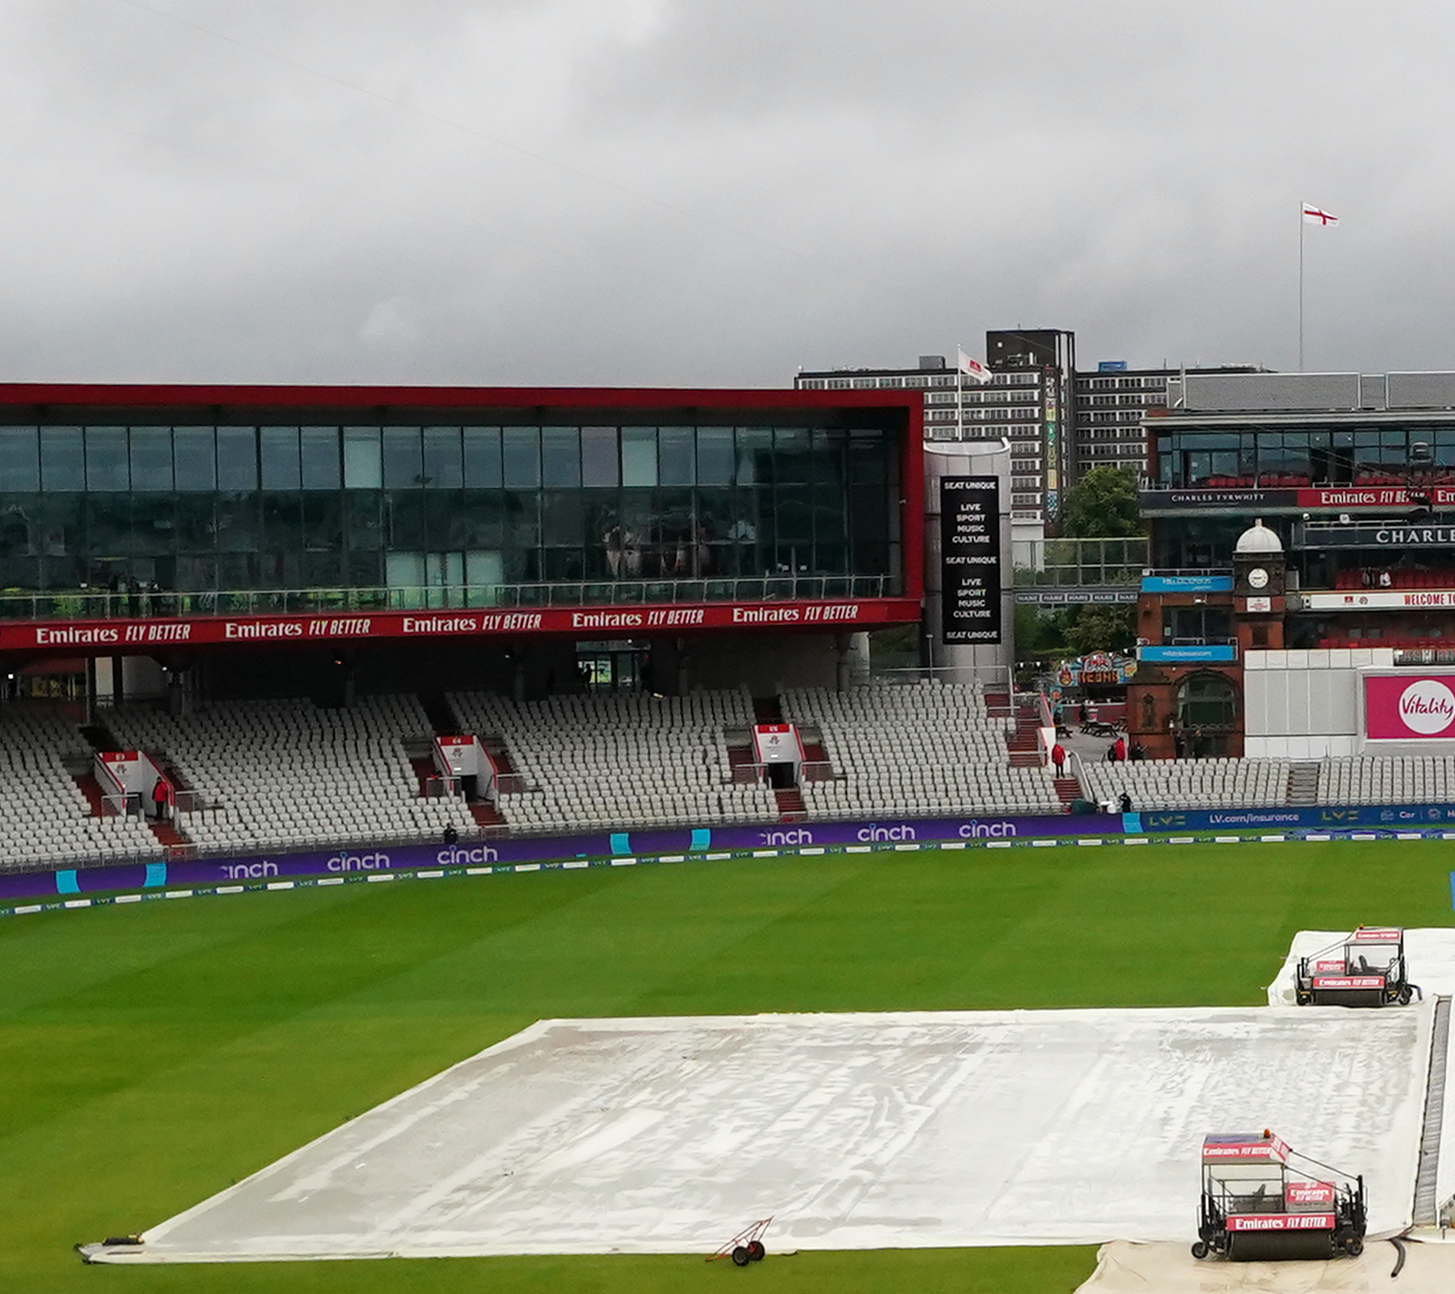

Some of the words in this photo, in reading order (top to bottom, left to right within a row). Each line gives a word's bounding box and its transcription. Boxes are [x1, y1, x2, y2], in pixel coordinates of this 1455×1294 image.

[1321, 491, 1376, 504] Emirates
[1380, 491, 1394, 502] FLY
[1404, 595, 1444, 605] WELCOME
[572, 612, 642, 628] Emirates
[648, 610, 665, 625] FLY
[666, 609, 704, 625] BETTER
[732, 606, 799, 622] Emirates
[804, 606, 821, 620] FLY
[822, 604, 858, 620] BETTER
[225, 622, 302, 639] Emirates
[308, 620, 328, 636] FLY
[329, 618, 371, 635] BETTER
[403, 616, 477, 633] Emirates
[482, 615, 502, 631] FLY
[503, 613, 542, 630] BETTER
[36, 627, 118, 645] Emirates
[125, 625, 145, 642] FLY
[146, 624, 191, 641] BETTER
[1403, 694, 1454, 715] Vitality
[1209, 812, 1299, 824] LV.com/insurance
[1399, 811, 1415, 819] Car
[857, 823, 915, 842] cinch
[959, 819, 1016, 838] cinch
[327, 851, 390, 872] cinch
[437, 845, 498, 866] cinch
[1235, 1219, 1283, 1230] Emirates
[1287, 1217, 1300, 1228] FLY
[1301, 1217, 1327, 1227] BETTER
